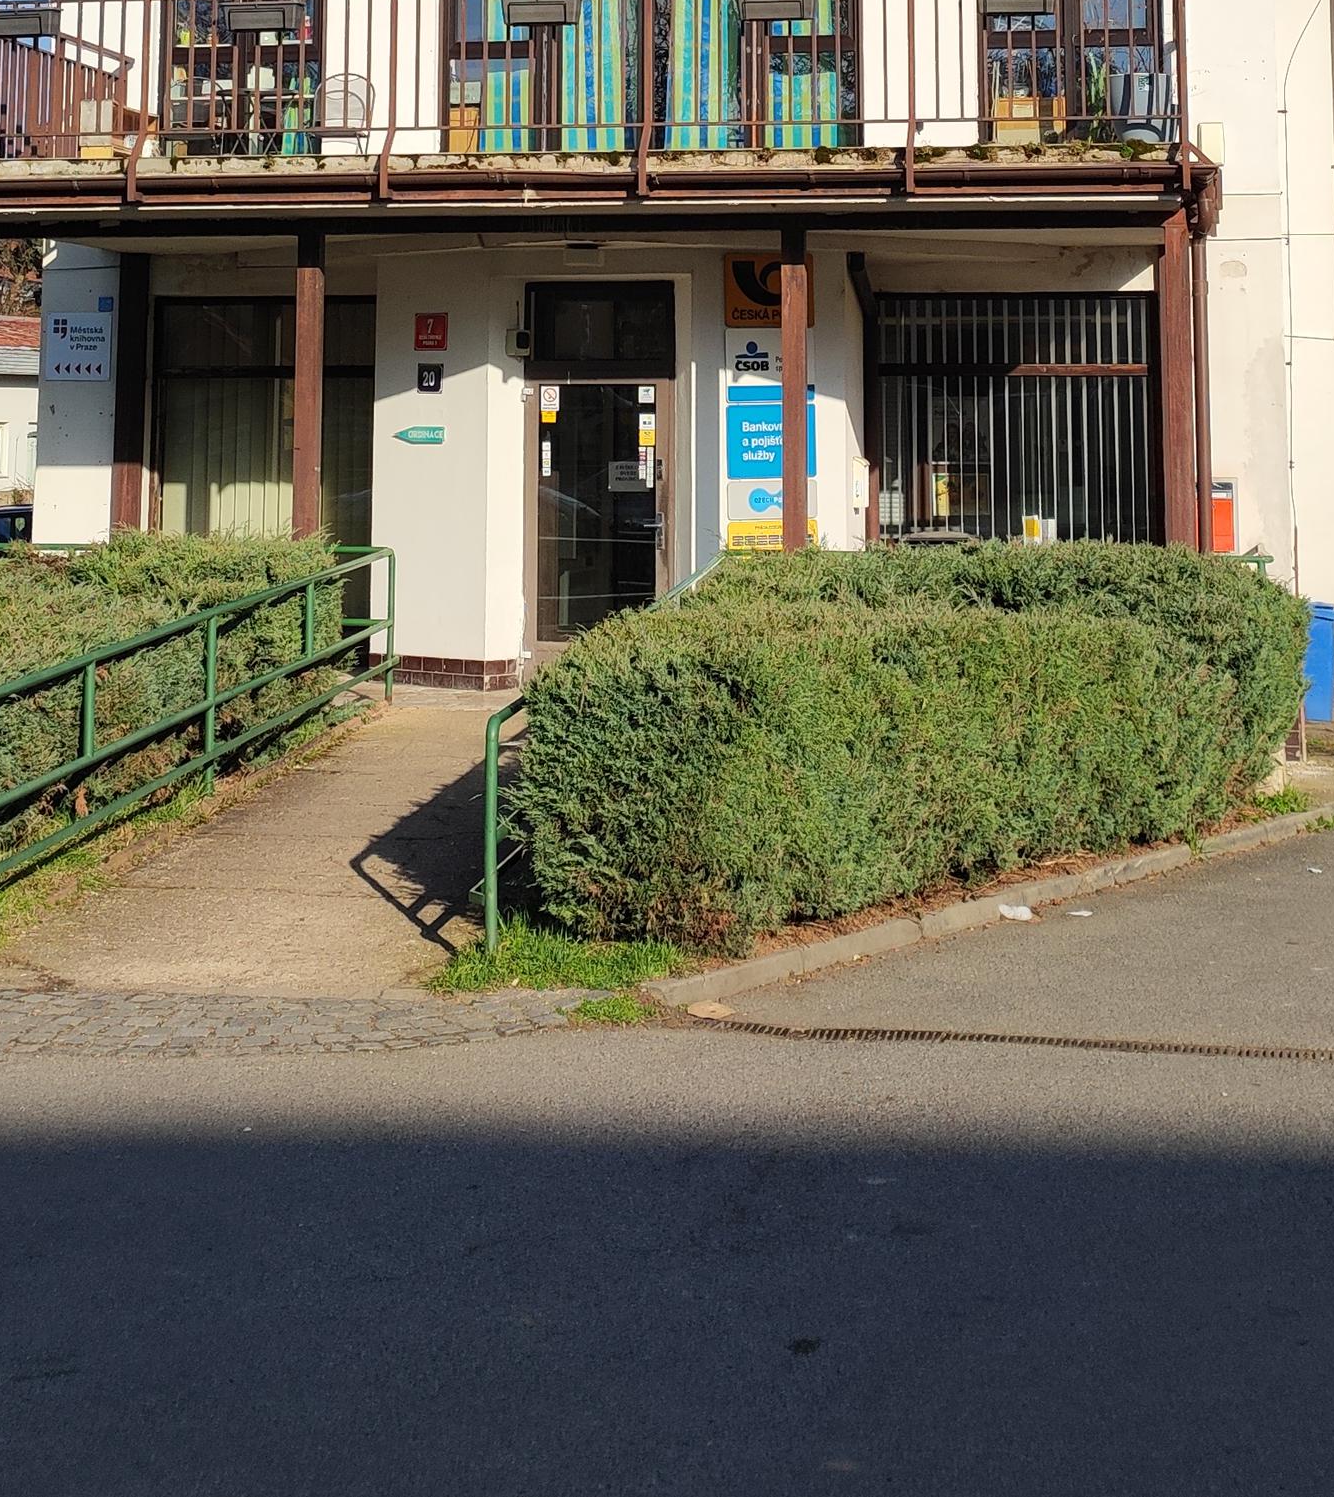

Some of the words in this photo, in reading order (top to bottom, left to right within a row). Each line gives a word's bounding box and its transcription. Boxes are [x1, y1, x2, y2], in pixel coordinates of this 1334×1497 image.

[731, 308, 770, 320] ČESKÁ
[772, 309, 782, 320] P
[70, 326, 104, 334] Městská
[427, 318, 435, 334] 7
[76, 343, 98, 351] Praze
[735, 359, 770, 372] ČSOB
[775, 365, 783, 373] sp
[422, 371, 435, 387] 20
[742, 421, 783, 432] Bankov
[742, 438, 749, 447] a
[751, 435, 783, 448] pojišť
[742, 450, 775, 462] služby
